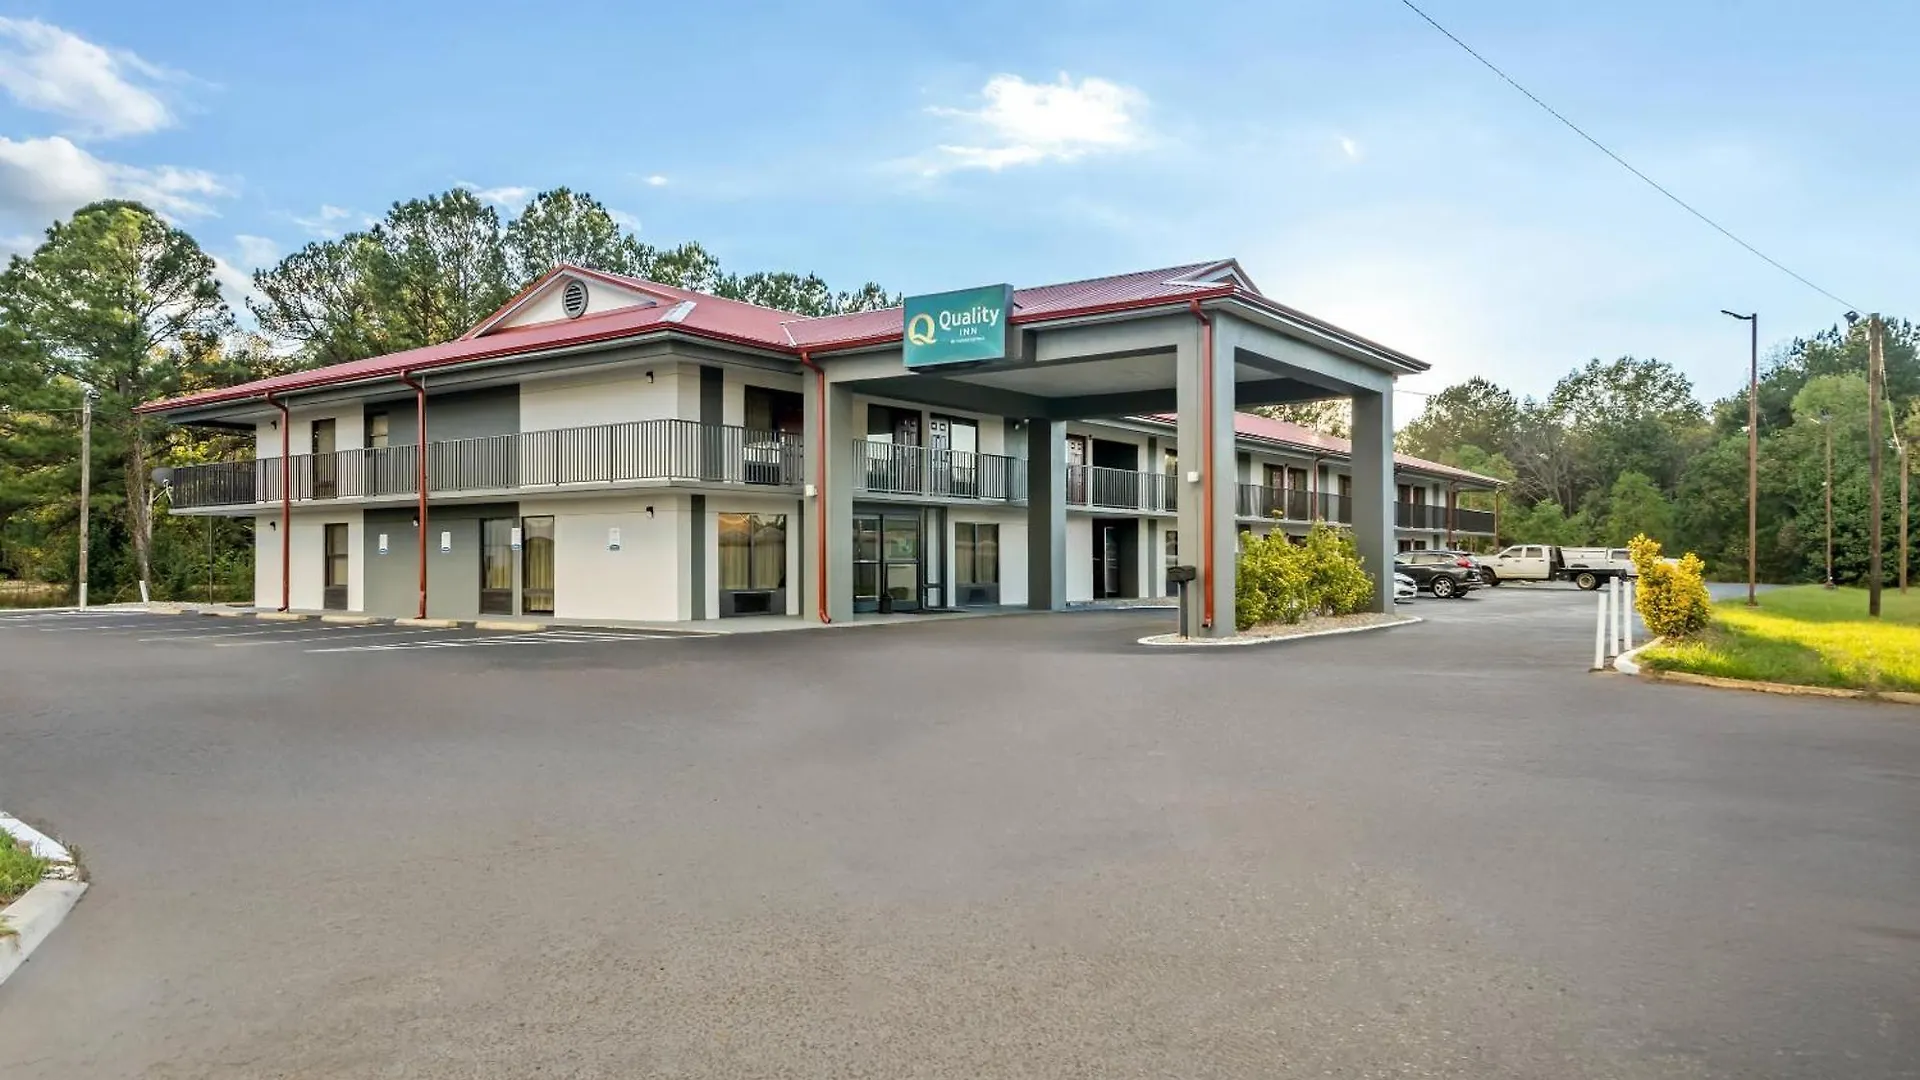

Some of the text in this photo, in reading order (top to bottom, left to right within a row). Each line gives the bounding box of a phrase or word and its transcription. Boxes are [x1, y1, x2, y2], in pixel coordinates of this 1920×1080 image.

[908, 313, 936, 345] Q
[939, 307, 1000, 330] Quality
[959, 327, 978, 336] INN
